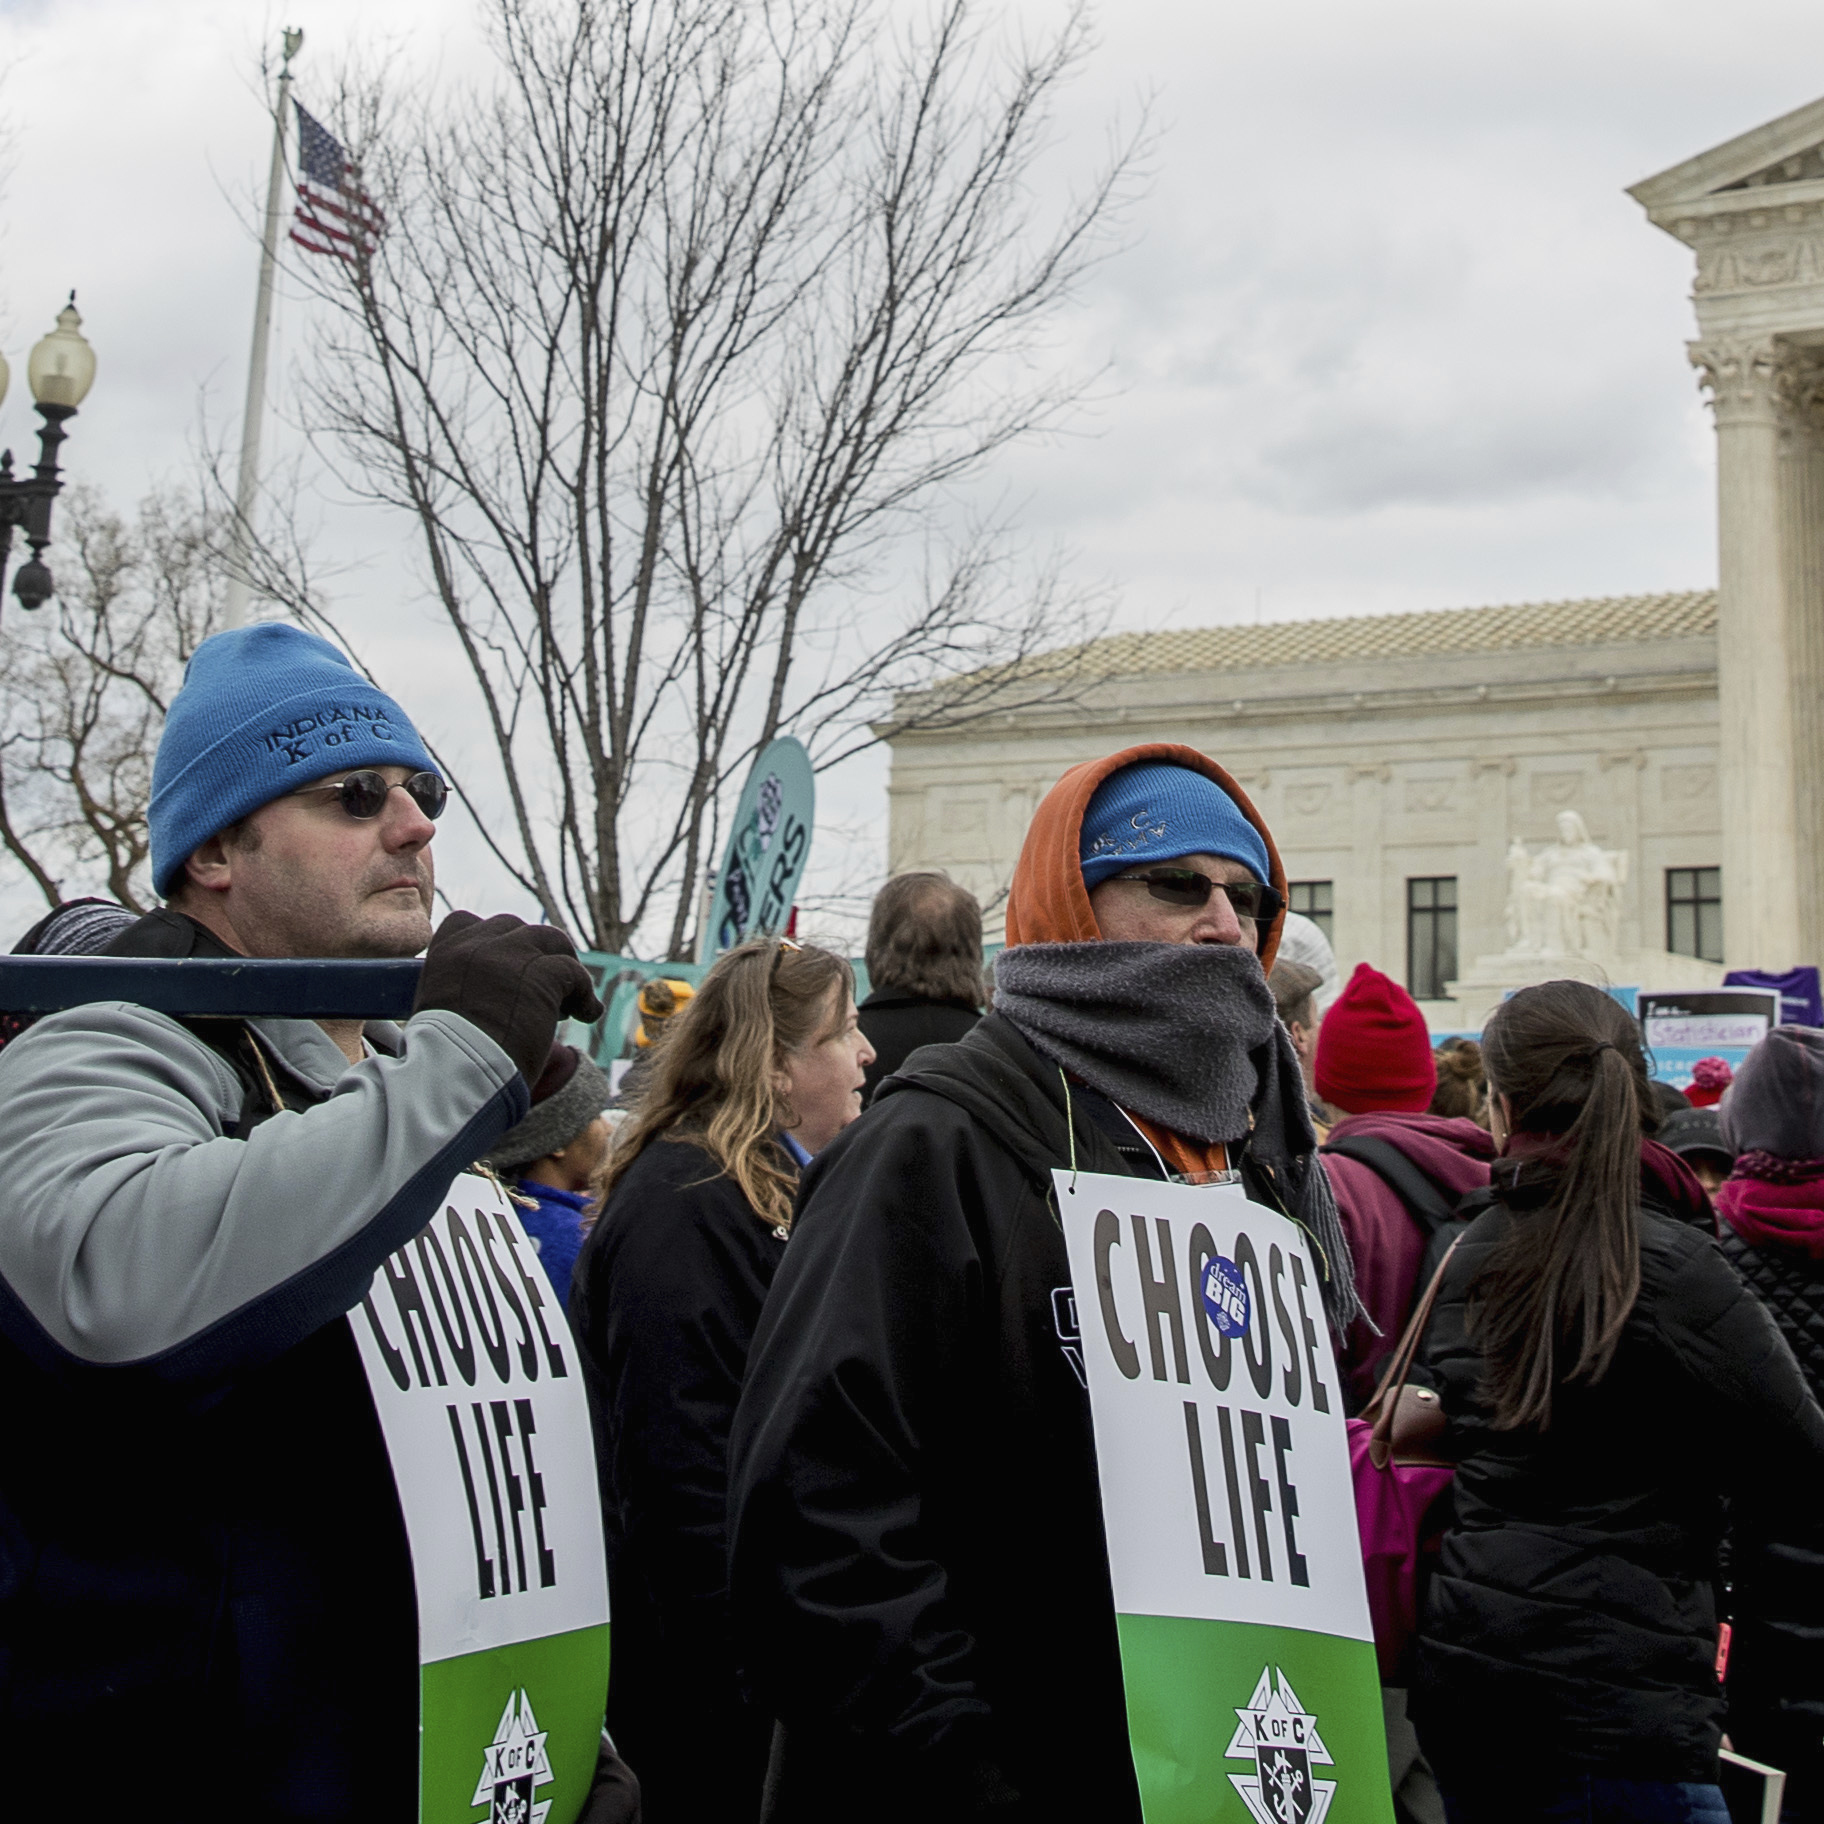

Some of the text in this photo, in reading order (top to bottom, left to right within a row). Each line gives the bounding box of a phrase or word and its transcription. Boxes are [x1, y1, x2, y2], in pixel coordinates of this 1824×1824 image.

[263, 706, 391, 753] INDIANA
[281, 723, 393, 767] K of C
[362, 1205, 569, 1392] CHOOSE
[1205, 1273, 1246, 1327] BIG
[1210, 1262, 1247, 1305] dream
[1093, 1208, 1331, 1416] CHOOSE
[446, 1398, 556, 1600] LIFE
[1182, 1400, 1310, 1589] LIFE
[1253, 1713, 1305, 1745] K OF C
[494, 1739, 535, 1779] K OF C
